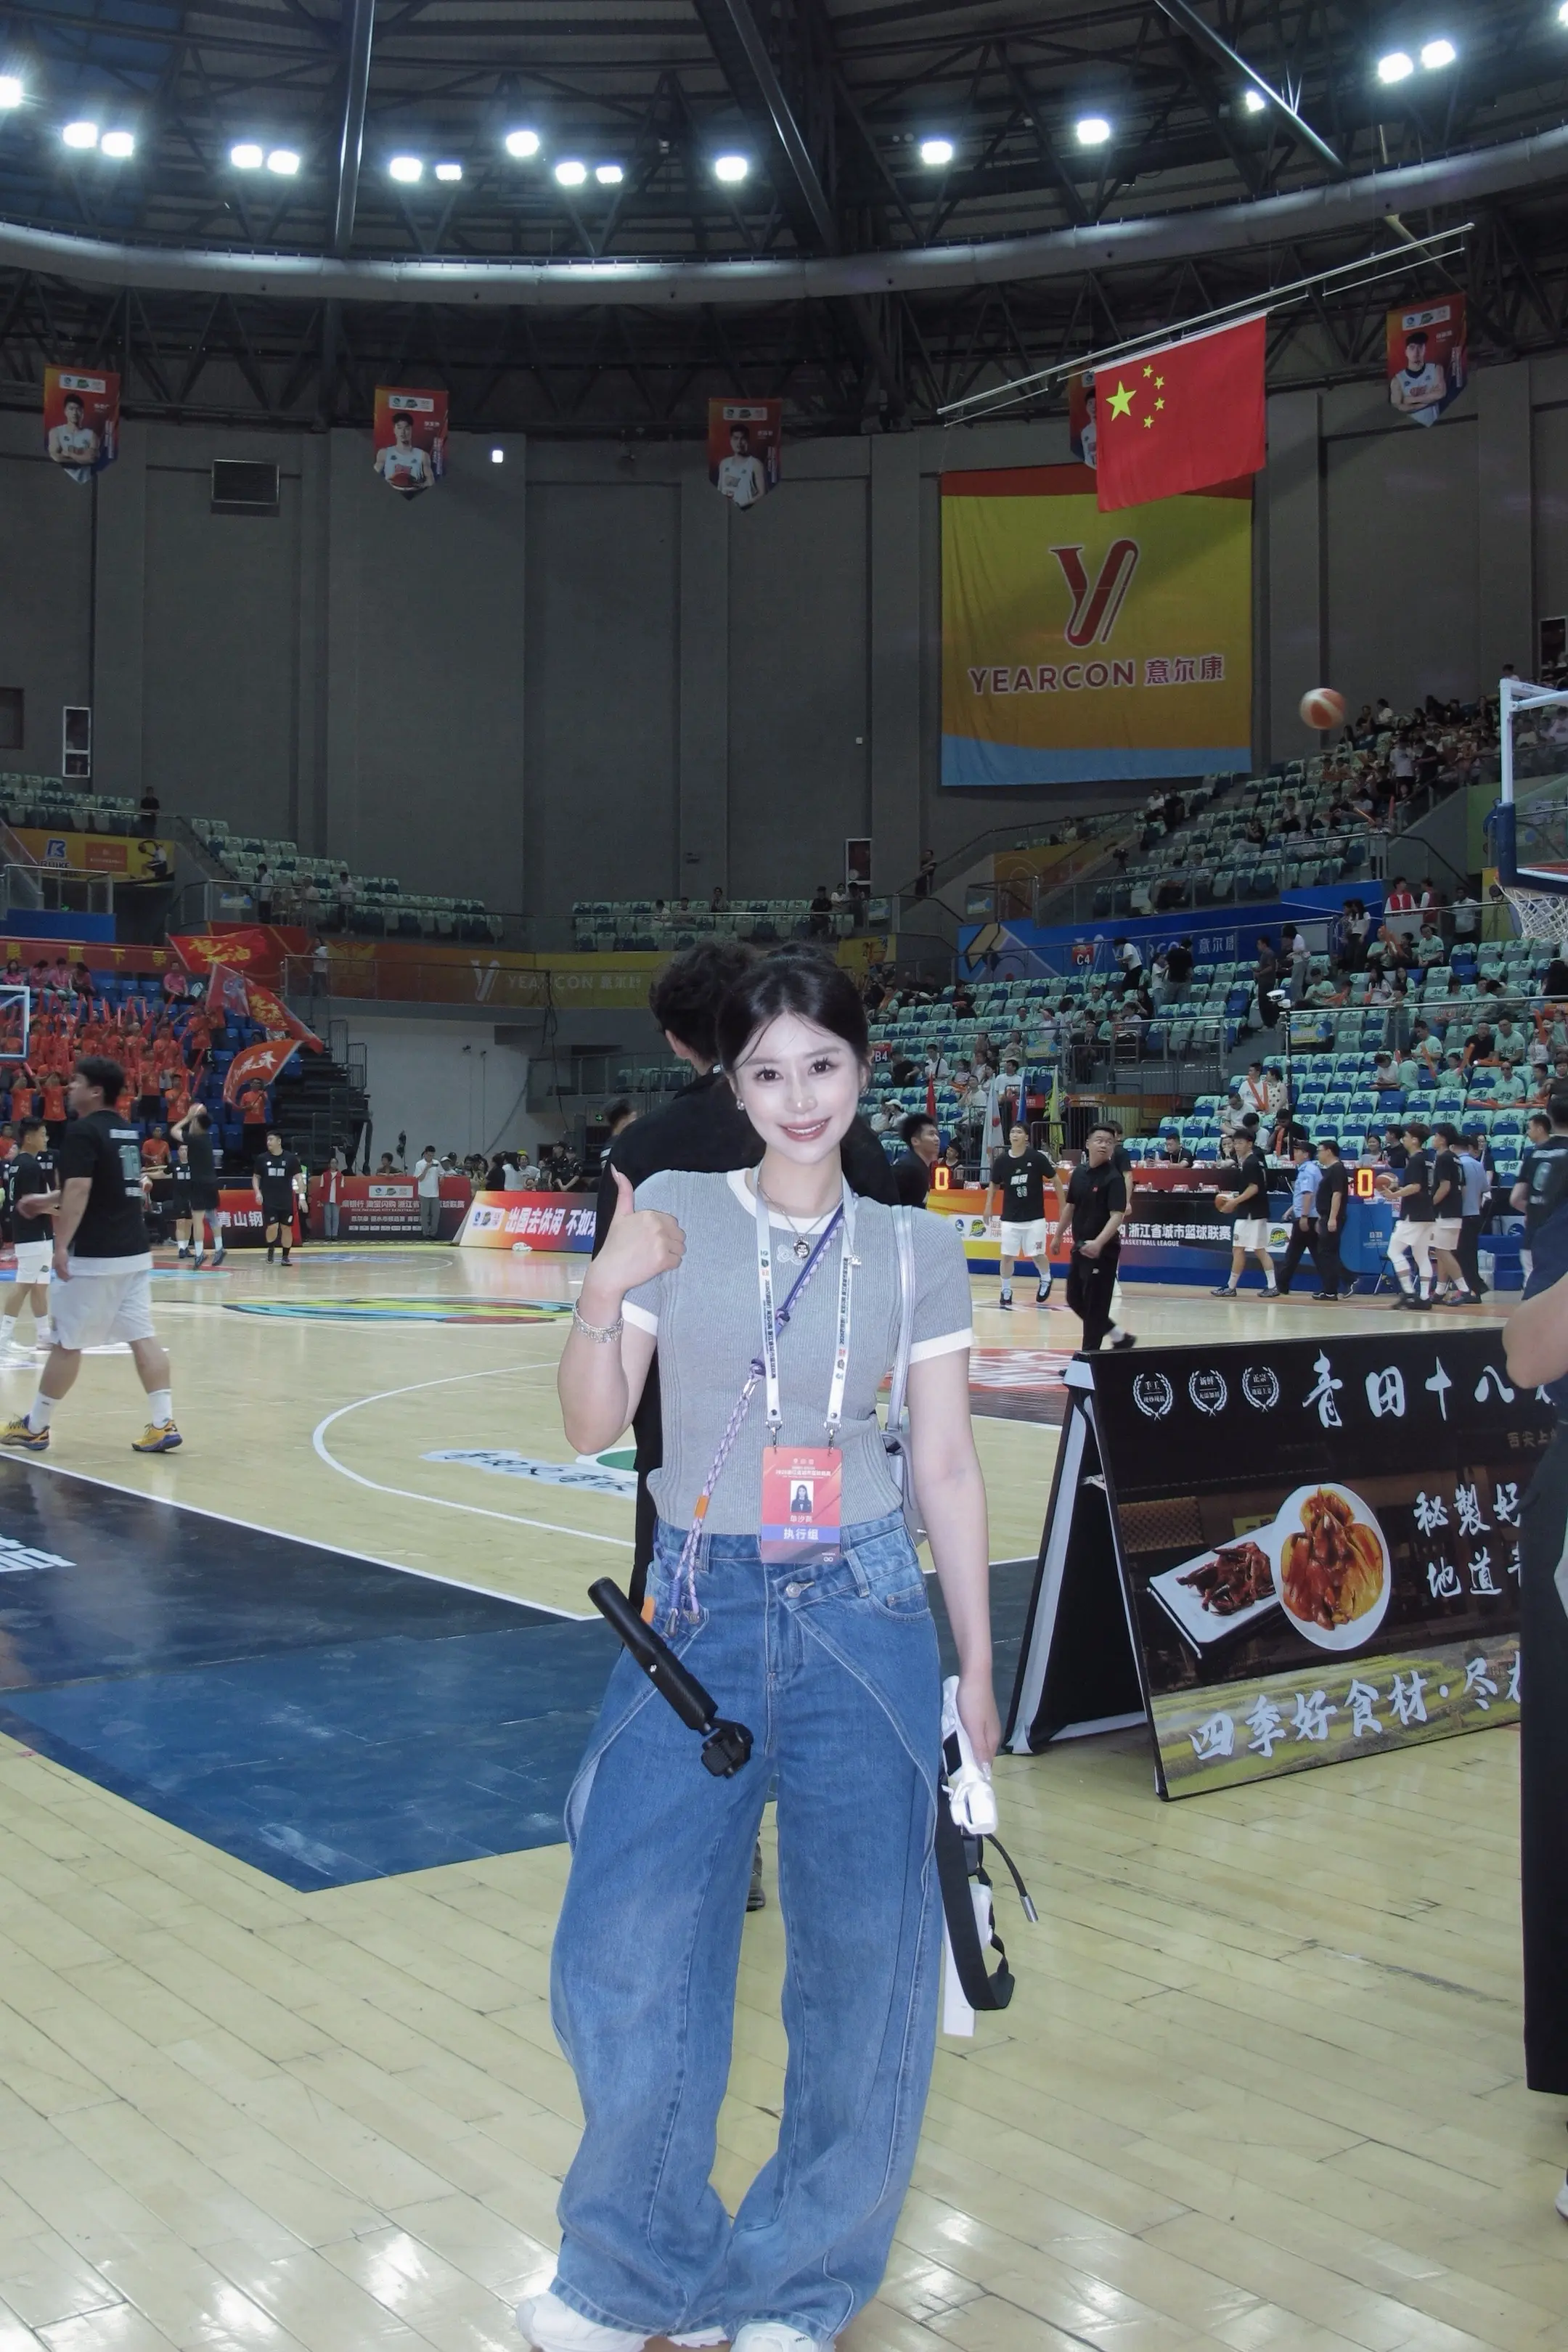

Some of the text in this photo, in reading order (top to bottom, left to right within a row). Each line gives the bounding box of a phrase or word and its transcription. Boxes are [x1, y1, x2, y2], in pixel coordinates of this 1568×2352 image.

[969, 655, 1222, 693] YEARCON 意尔康
[1077, 953, 1090, 965] C4
[935, 1167, 949, 1191] 0
[1357, 1169, 1374, 1197] 0
[505, 1206, 565, 1236] 出国去休闲
[1128, 1223, 1232, 1241] 浙江省城市篮球联赛
[1145, 1381, 1160, 1390] 手工
[1199, 1376, 1214, 1387] 新鲜
[1413, 1482, 1520, 1537] 秘製好
[783, 1527, 820, 1541] 执行组
